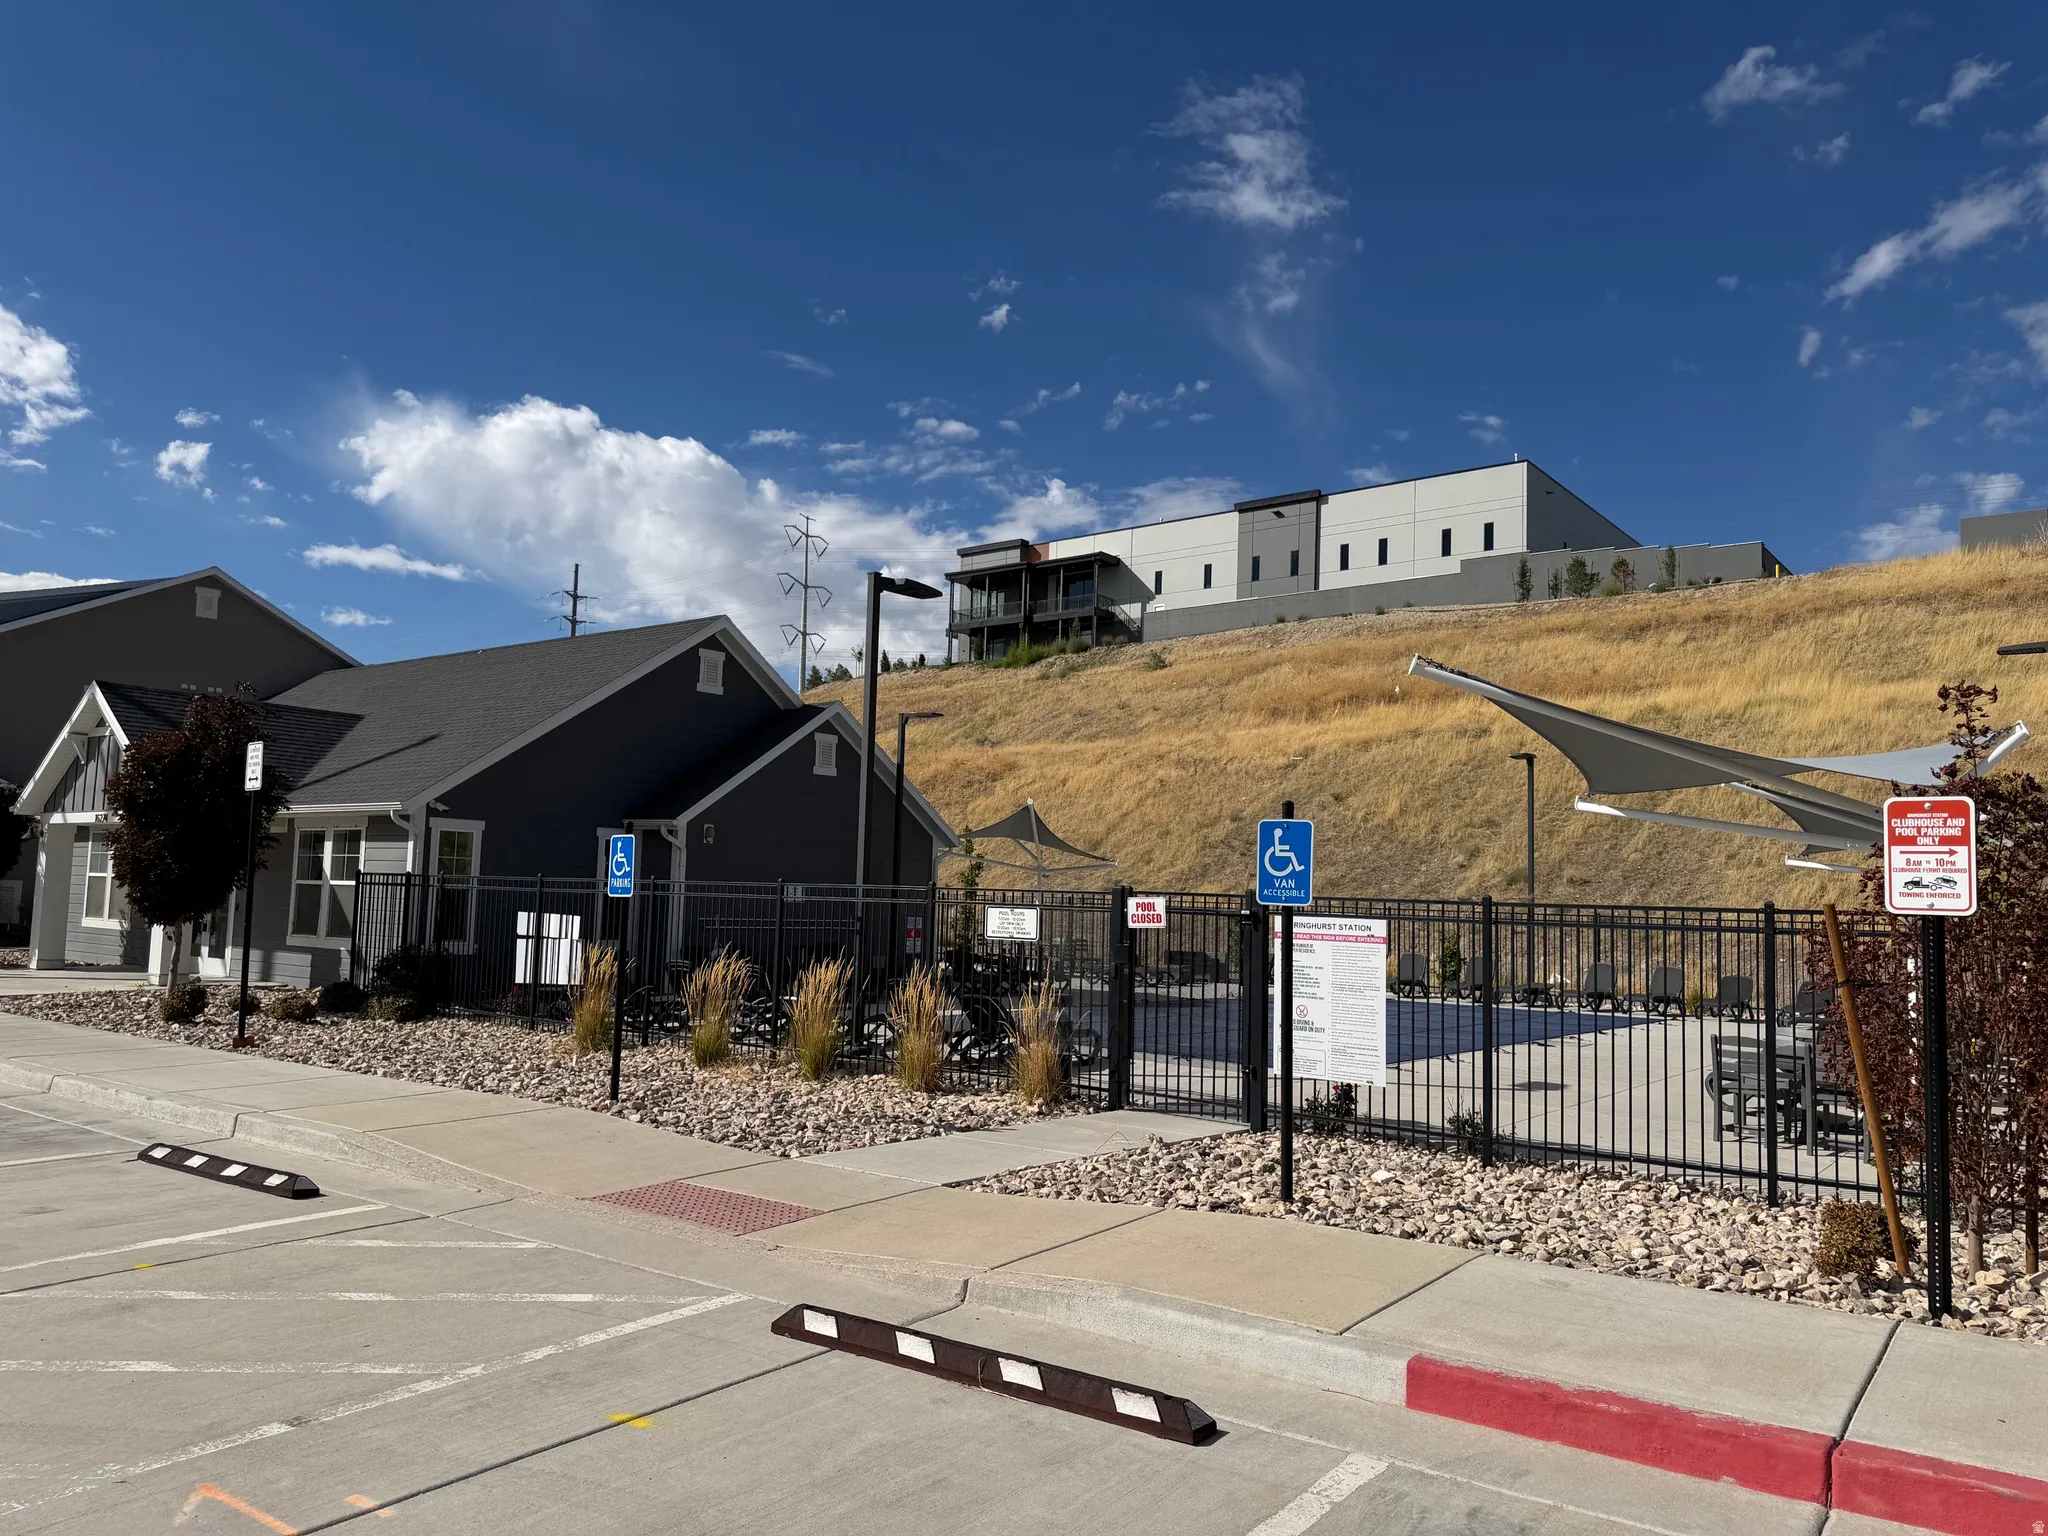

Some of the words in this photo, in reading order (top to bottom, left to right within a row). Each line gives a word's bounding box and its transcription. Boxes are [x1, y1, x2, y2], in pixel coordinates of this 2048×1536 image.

[1892, 818, 1944, 827] CLUBHOUSE
[1946, 818, 1965, 826] AND
[1895, 828, 1919, 836] POOL
[1921, 828, 1961, 836] PARKING
[1917, 837, 1940, 845] ONLY
[611, 878, 630, 887] PARKING
[1274, 879, 1295, 888] VAN
[1136, 902, 1156, 912] POOL
[1131, 913, 1162, 923] CLOSED
[1294, 922, 1336, 930] RINGHURST
